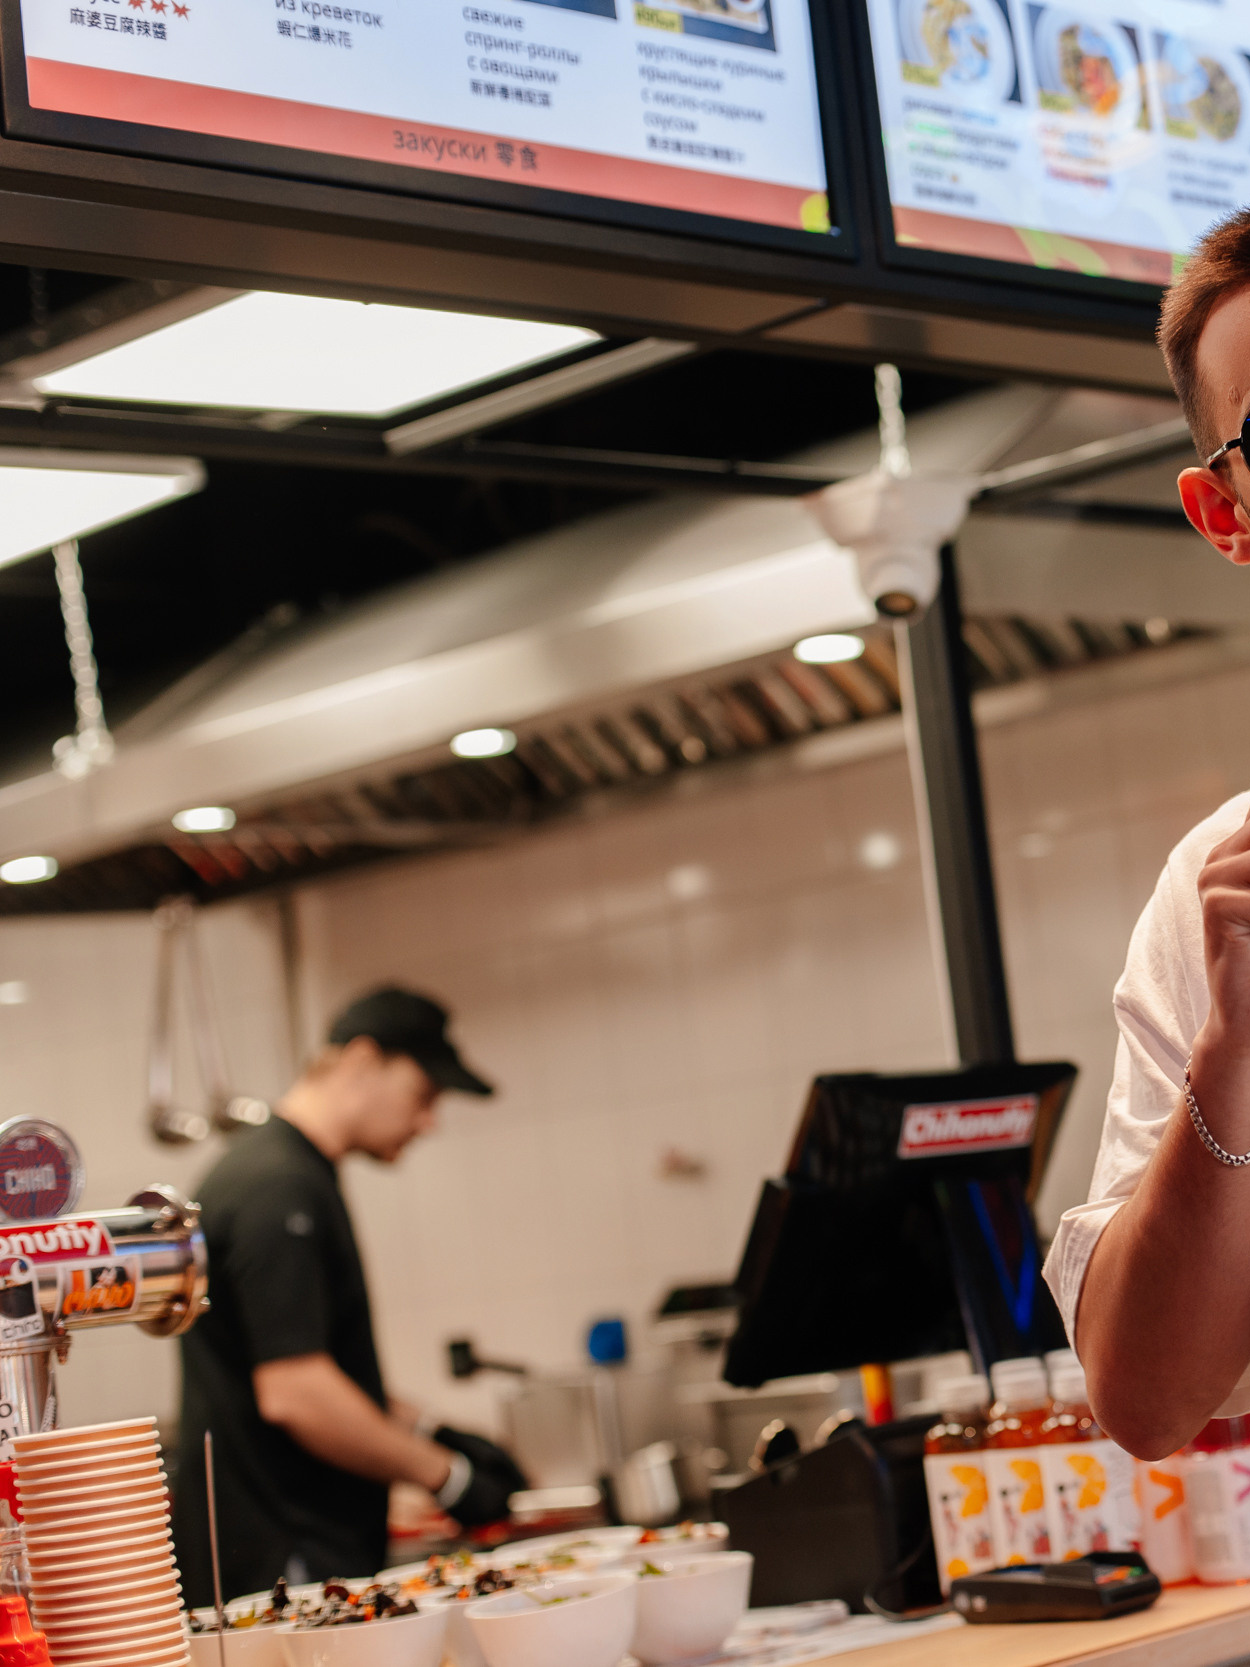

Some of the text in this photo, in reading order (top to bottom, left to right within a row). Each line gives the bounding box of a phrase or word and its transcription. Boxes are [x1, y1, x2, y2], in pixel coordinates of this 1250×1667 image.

[301, 2, 384, 28] креветок
[462, 6, 524, 31] свежие
[465, 30, 582, 67] спринг-роллы
[480, 57, 559, 83] овощами
[393, 130, 486, 162] закуски
